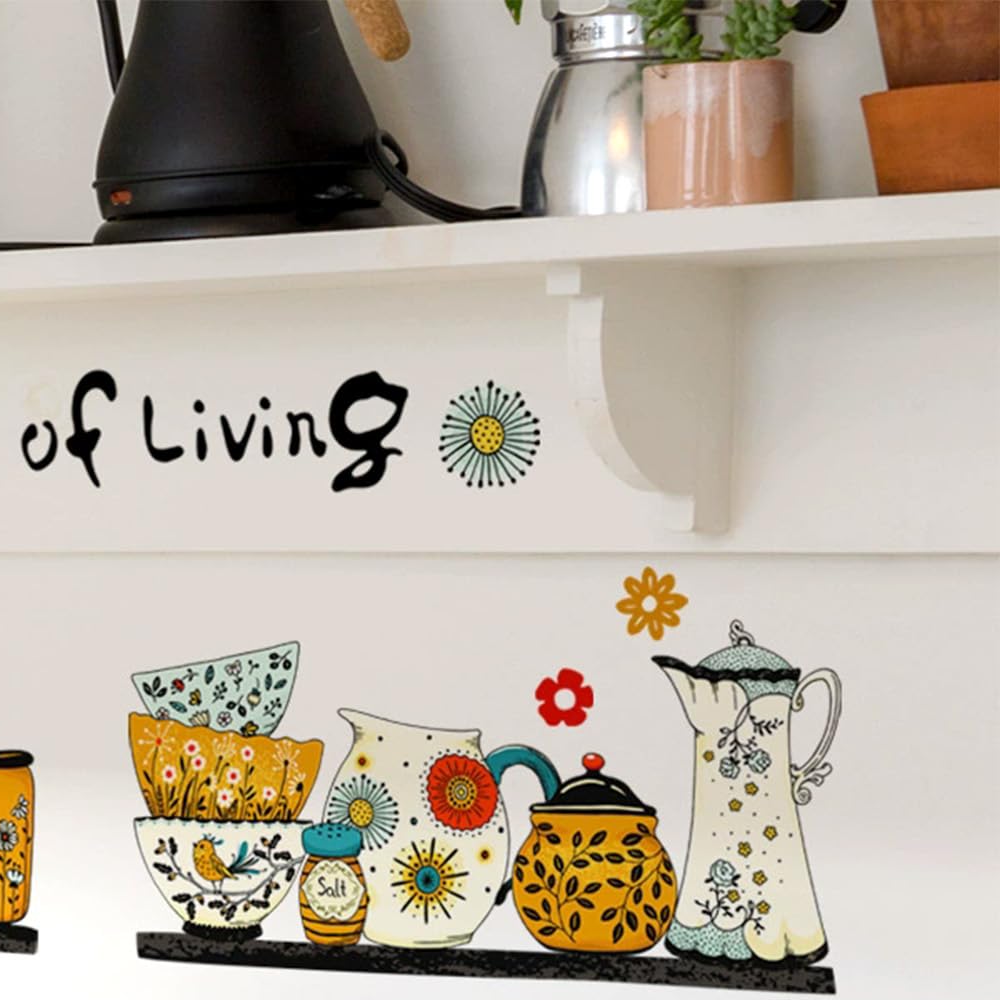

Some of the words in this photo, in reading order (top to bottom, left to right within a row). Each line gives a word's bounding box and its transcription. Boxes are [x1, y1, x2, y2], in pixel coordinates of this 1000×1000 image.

[22, 370, 117, 488] of
[143, 371, 409, 493] Living
[317, 876, 347, 898] Salt
